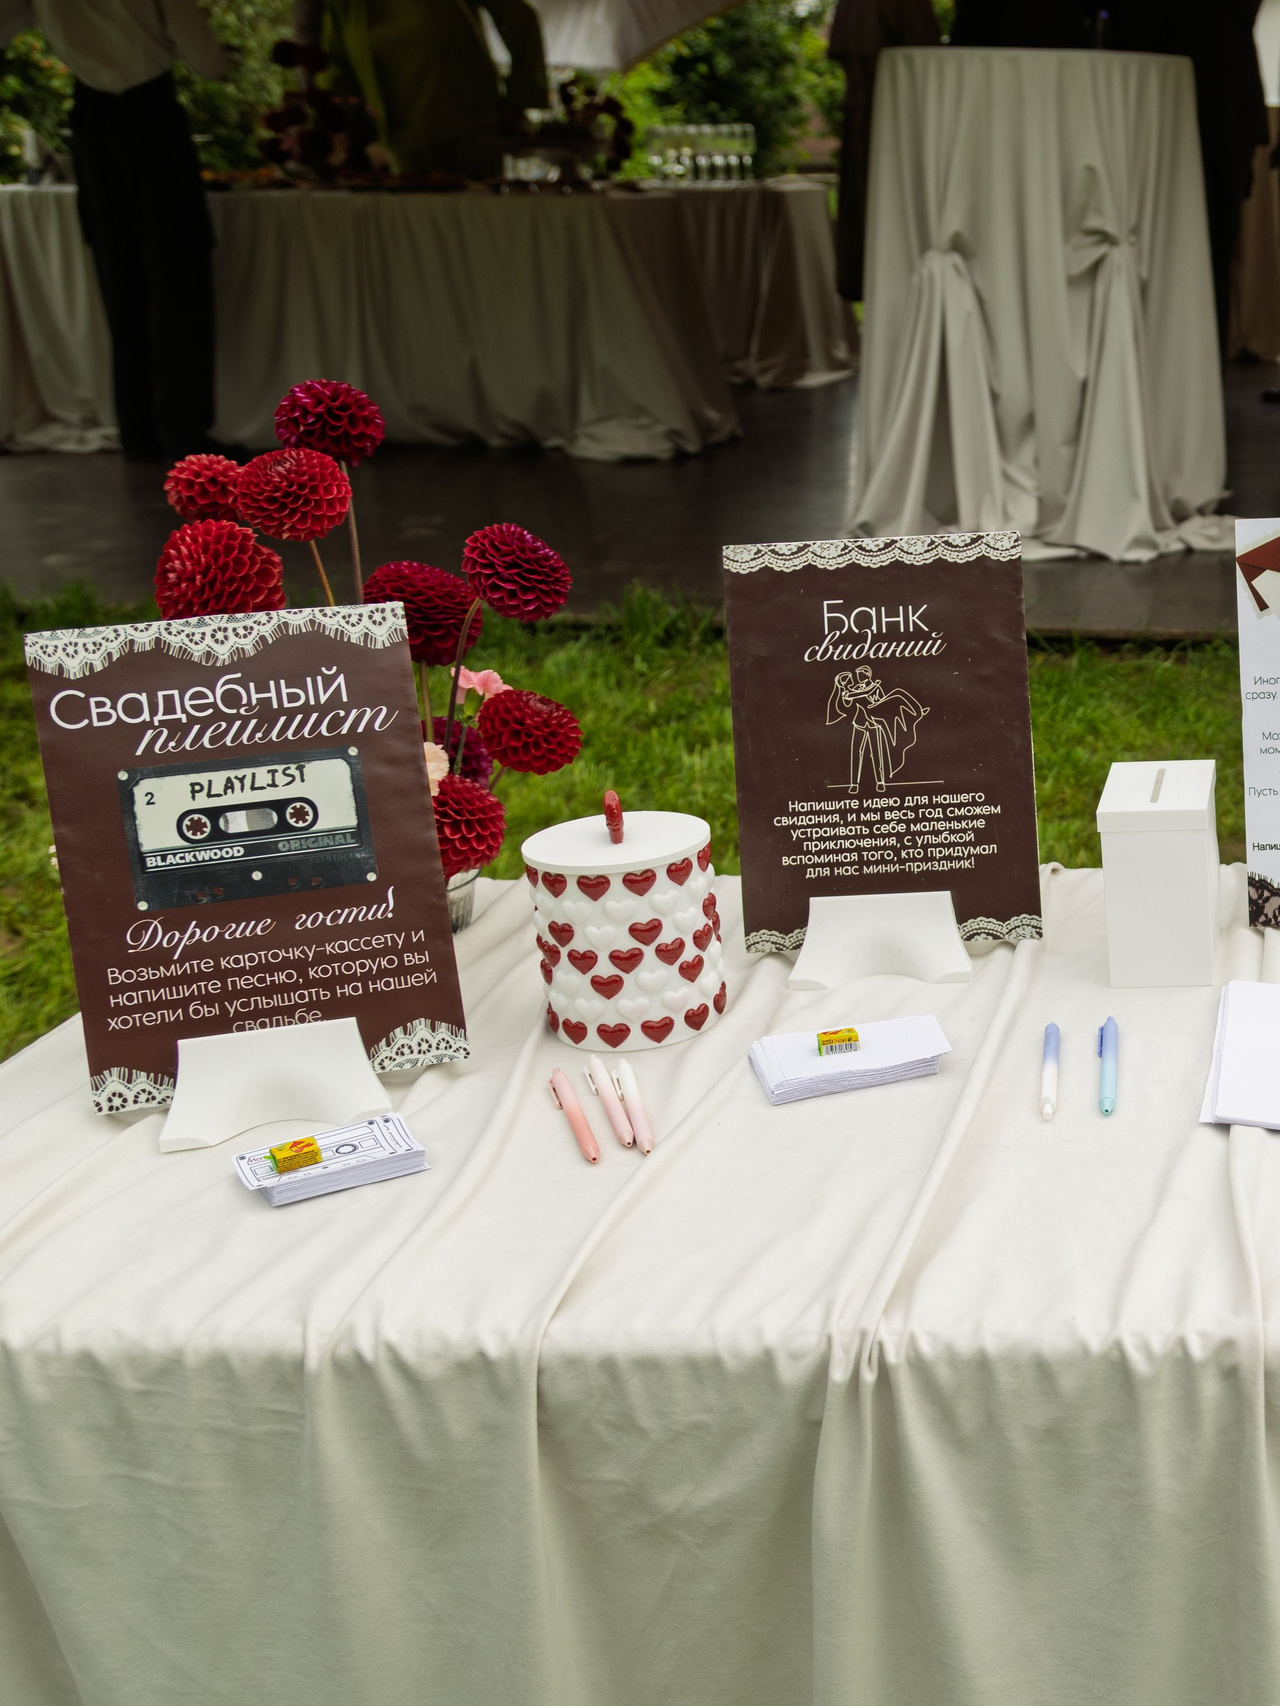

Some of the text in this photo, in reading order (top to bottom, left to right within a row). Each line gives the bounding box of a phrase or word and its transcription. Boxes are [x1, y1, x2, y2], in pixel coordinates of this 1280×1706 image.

[823, 600, 930, 635] Банк
[803, 628, 948, 662] свиданий
[49, 665, 348, 730] Свадебный
[1245, 691, 1279, 702] сразу.
[134, 704, 400, 756] плейлист
[189, 763, 307, 802] PLAYLIST
[1248, 786, 1279, 799] Пусть
[144, 791, 156, 806] 2
[788, 792, 986, 813] Напишите идею для нашего
[773, 804, 1002, 827] свидания, и мы весь год сможем
[277, 831, 356, 853] ORIGINAL
[790, 818, 986, 842] устраивать себе маленькие
[803, 830, 975, 854] приключения, с улыбкой
[145, 845, 245, 869] BLACKWOOD
[781, 843, 998, 866] вспоминая того, кто придумал
[805, 856, 975, 880] для нас мини-приздник!
[125, 885, 395, 960] Дорогие гости!
[106, 929, 425, 986] Возьмите карточку-кассету и
[109, 950, 430, 1008] напишите песню, которую вы
[106, 967, 438, 1032] хотели бы услышать на нашей
